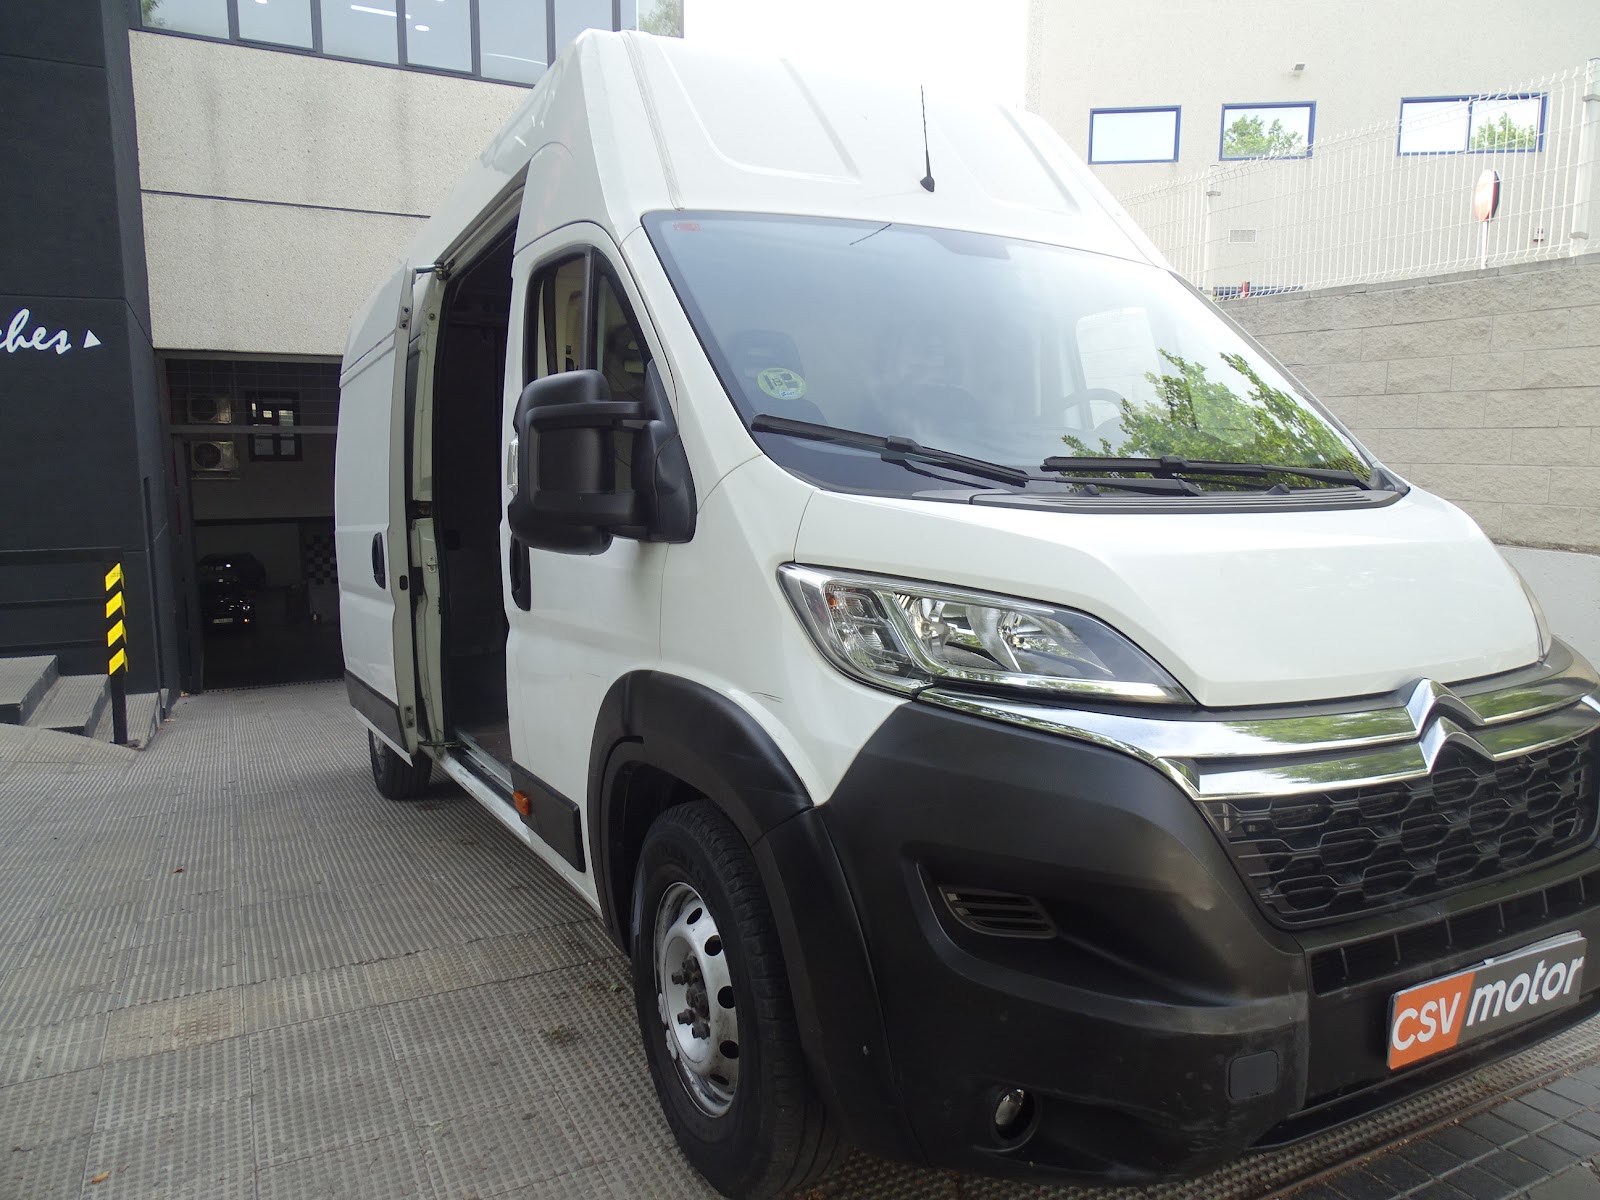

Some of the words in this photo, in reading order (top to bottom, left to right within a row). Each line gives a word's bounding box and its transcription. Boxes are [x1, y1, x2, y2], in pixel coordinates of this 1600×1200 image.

[0, 308, 72, 355] hes
[1392, 992, 1461, 1050] CSV
[1466, 956, 1584, 1026] motor
